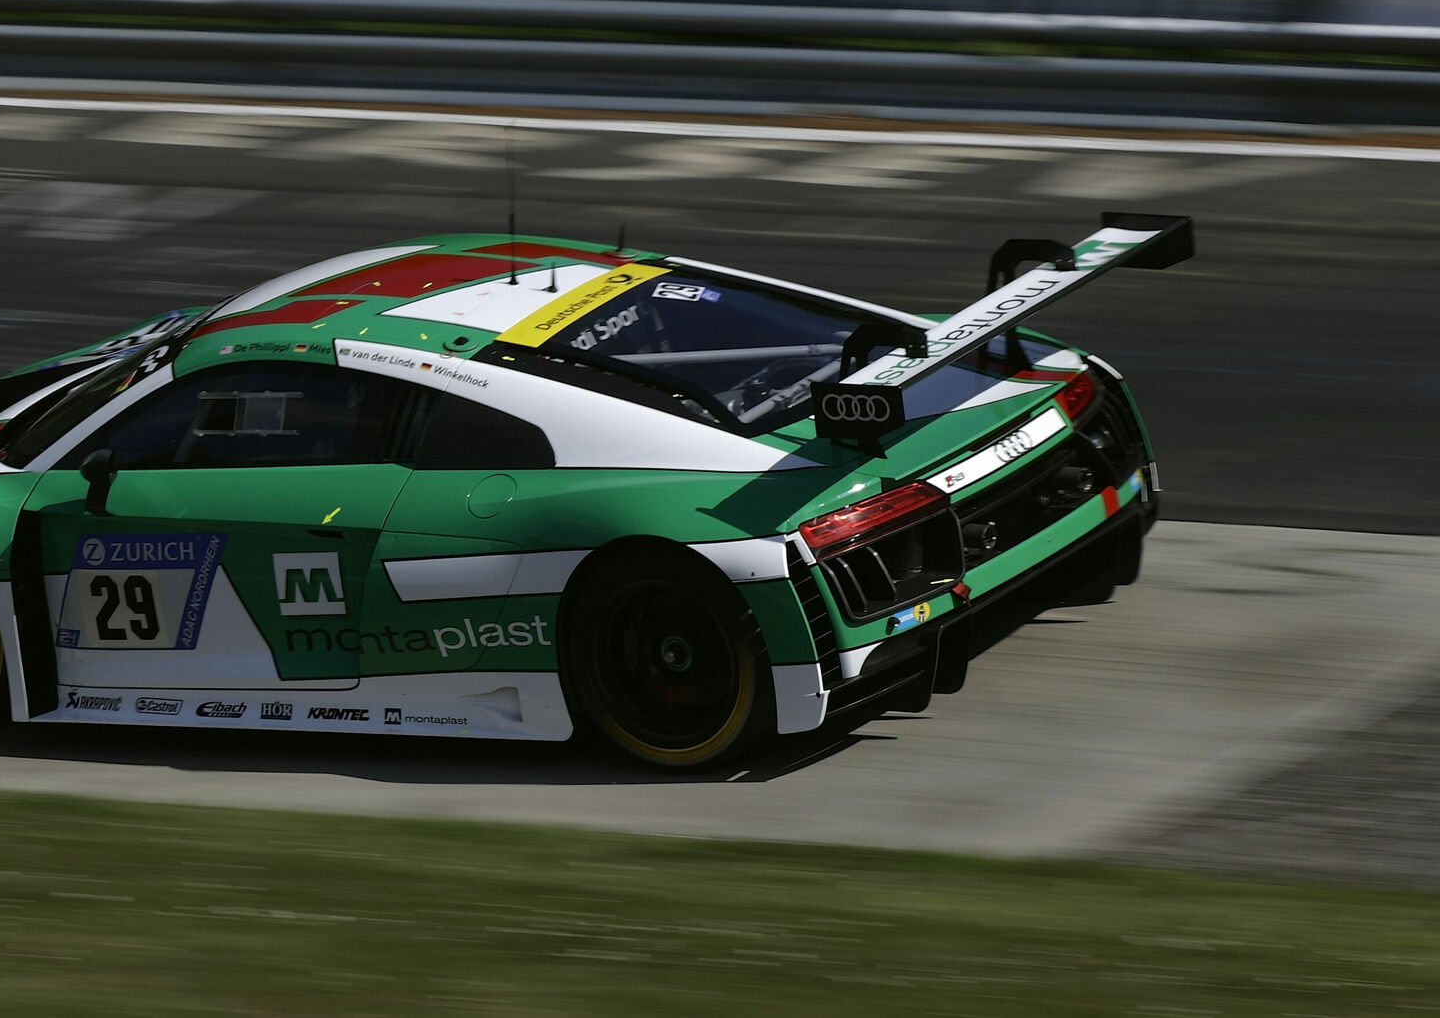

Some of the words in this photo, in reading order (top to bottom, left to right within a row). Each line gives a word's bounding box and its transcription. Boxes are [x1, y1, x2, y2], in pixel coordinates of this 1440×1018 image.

[535, 298, 593, 330] Deutsche
[233, 345, 247, 353] De
[308, 344, 331, 354] Mies
[570, 328, 598, 351] di
[352, 350, 369, 360] van
[371, 353, 387, 362] der
[389, 355, 416, 369] Linde
[433, 365, 489, 388] Winkelhock
[109, 541, 195, 563] ZURICH
[181, 611, 198, 647] ADAC
[192, 535, 221, 611] NORDRHEIN
[90, 575, 160, 640] 29
[285, 615, 552, 658] montaplast
[147, 700, 178, 713] Castrol
[196, 701, 247, 717] Eibach
[405, 715, 468, 726] montaplast
